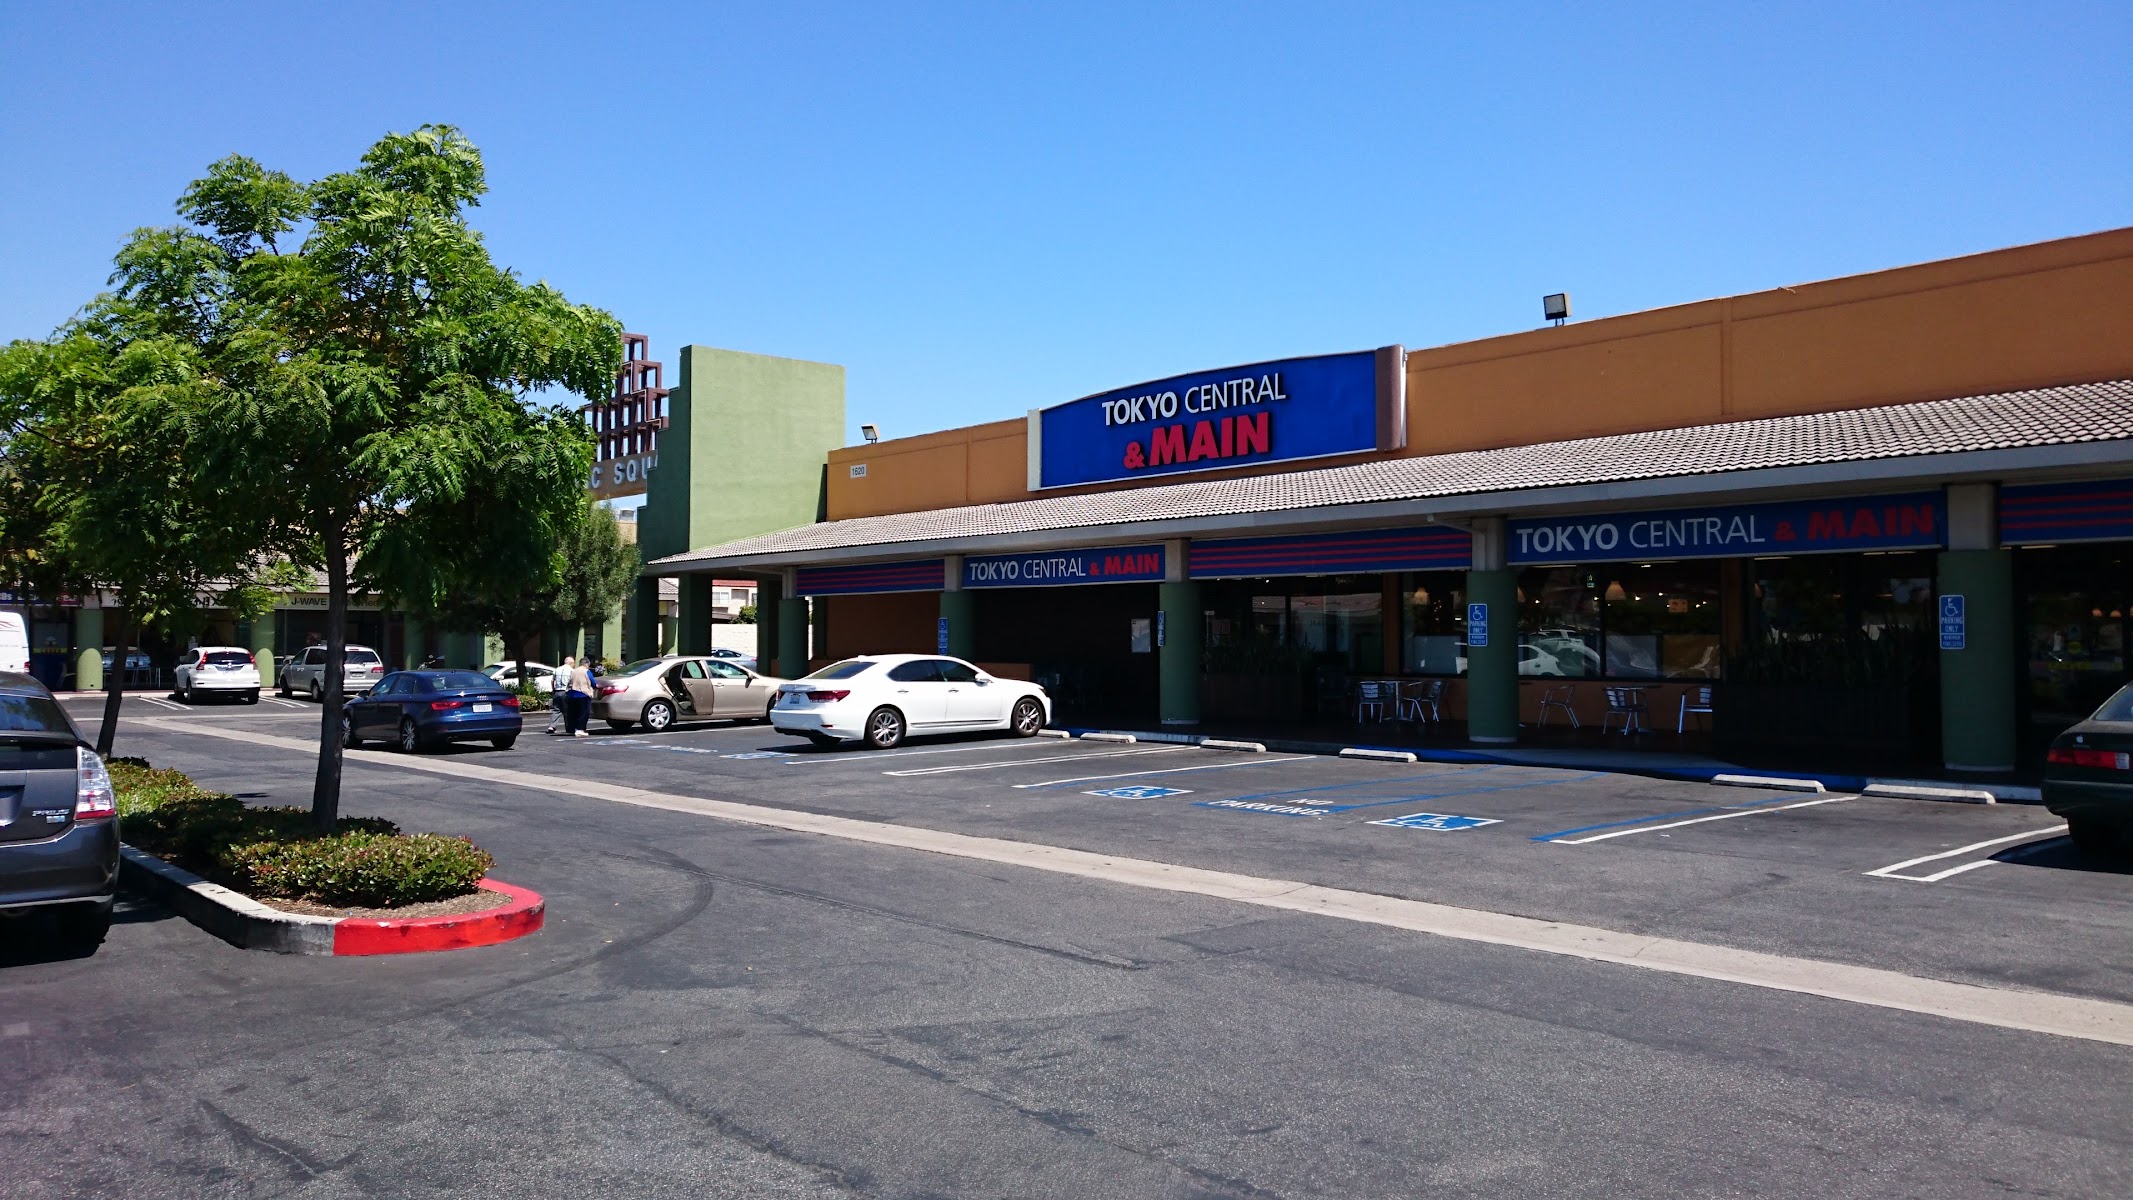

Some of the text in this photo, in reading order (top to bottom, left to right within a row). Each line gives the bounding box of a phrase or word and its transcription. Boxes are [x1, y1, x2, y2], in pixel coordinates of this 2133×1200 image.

[1101, 372, 1287, 427] TOKYO CENTRAL
[613, 455, 659, 485] SQU
[851, 466, 865, 476] 1620
[1516, 503, 1935, 554] TOKYO CENTRAL & MAIN
[969, 553, 1160, 581] TOKYO CENTRAL & MAIN
[291, 597, 327, 606] J-WAVE
[1208, 800, 1329, 816] PARKING
